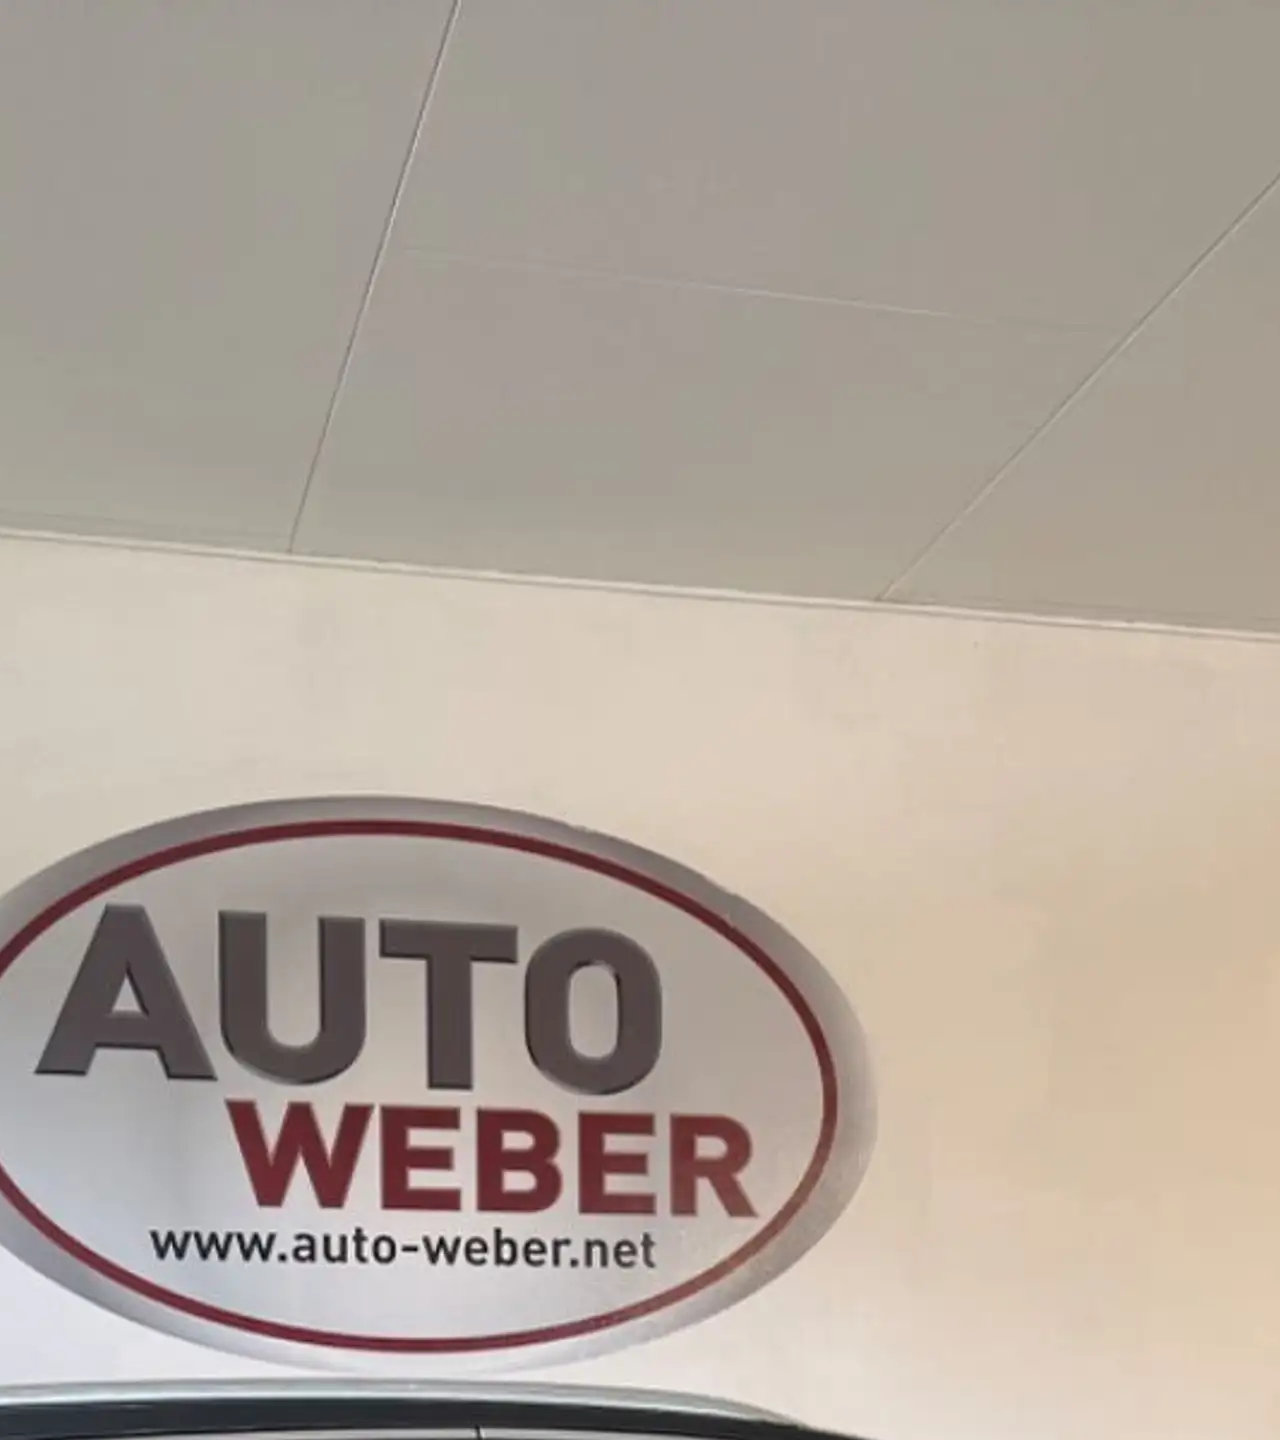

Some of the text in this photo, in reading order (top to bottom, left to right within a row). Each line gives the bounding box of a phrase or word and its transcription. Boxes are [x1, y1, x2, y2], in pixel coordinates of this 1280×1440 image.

[34, 903, 663, 1096] AUTO
[224, 1098, 758, 1218] WEBER
[149, 1226, 657, 1269] www.auto-weber.net
